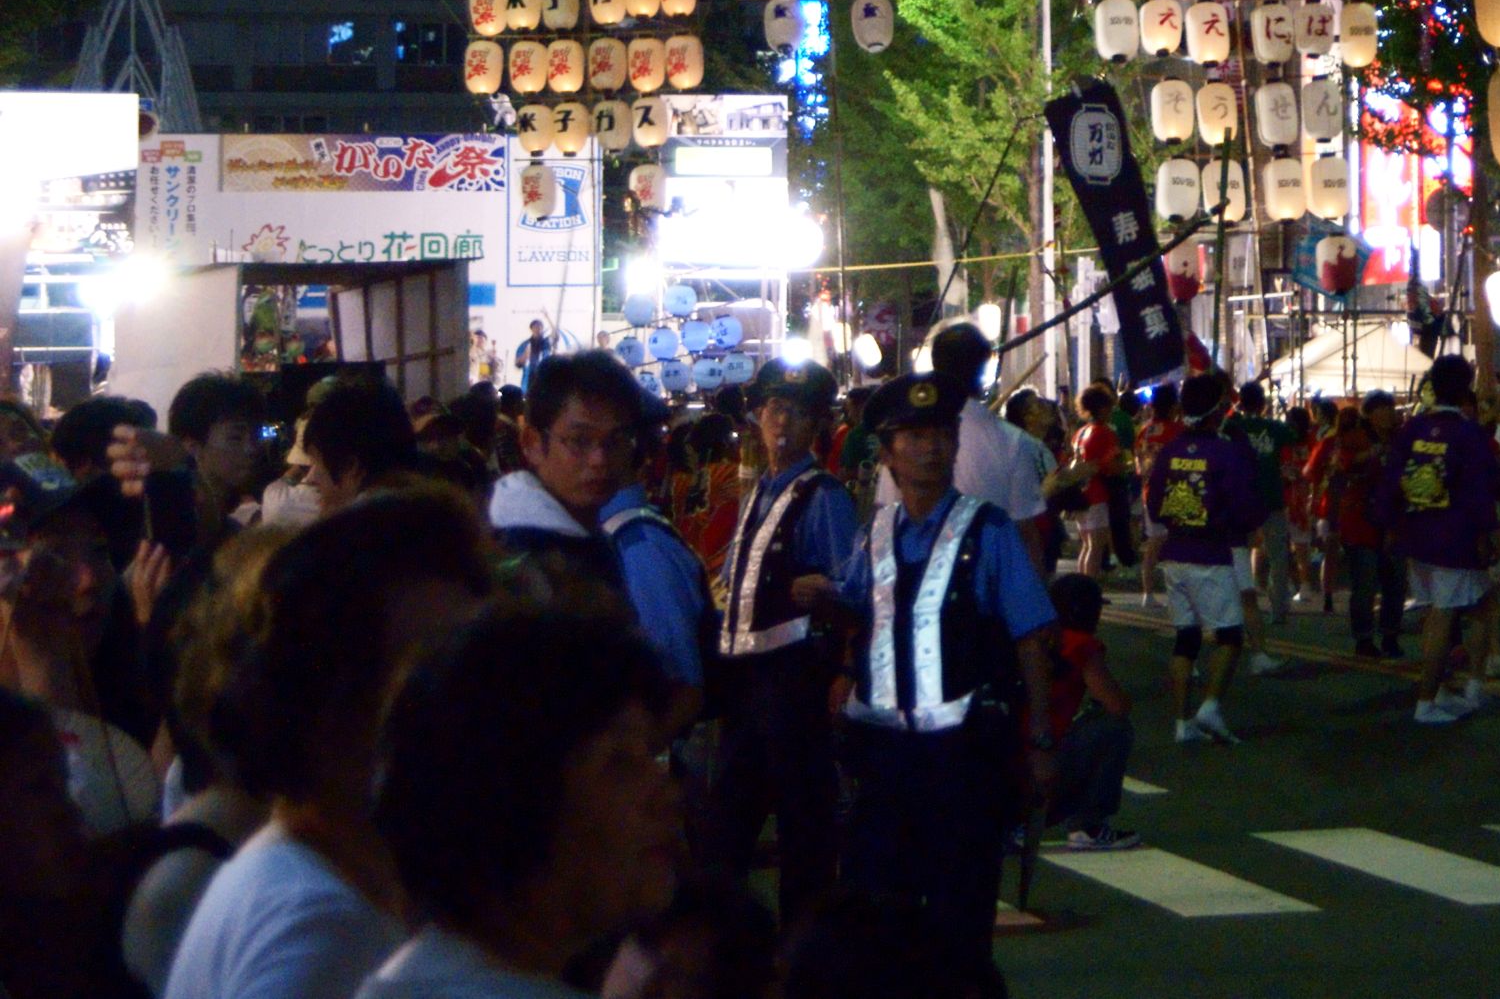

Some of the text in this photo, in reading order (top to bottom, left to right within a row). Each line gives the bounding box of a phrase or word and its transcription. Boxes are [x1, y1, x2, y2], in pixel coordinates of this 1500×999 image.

[334, 138, 500, 188] がいな祭
[517, 250, 590, 263] LAWSON
